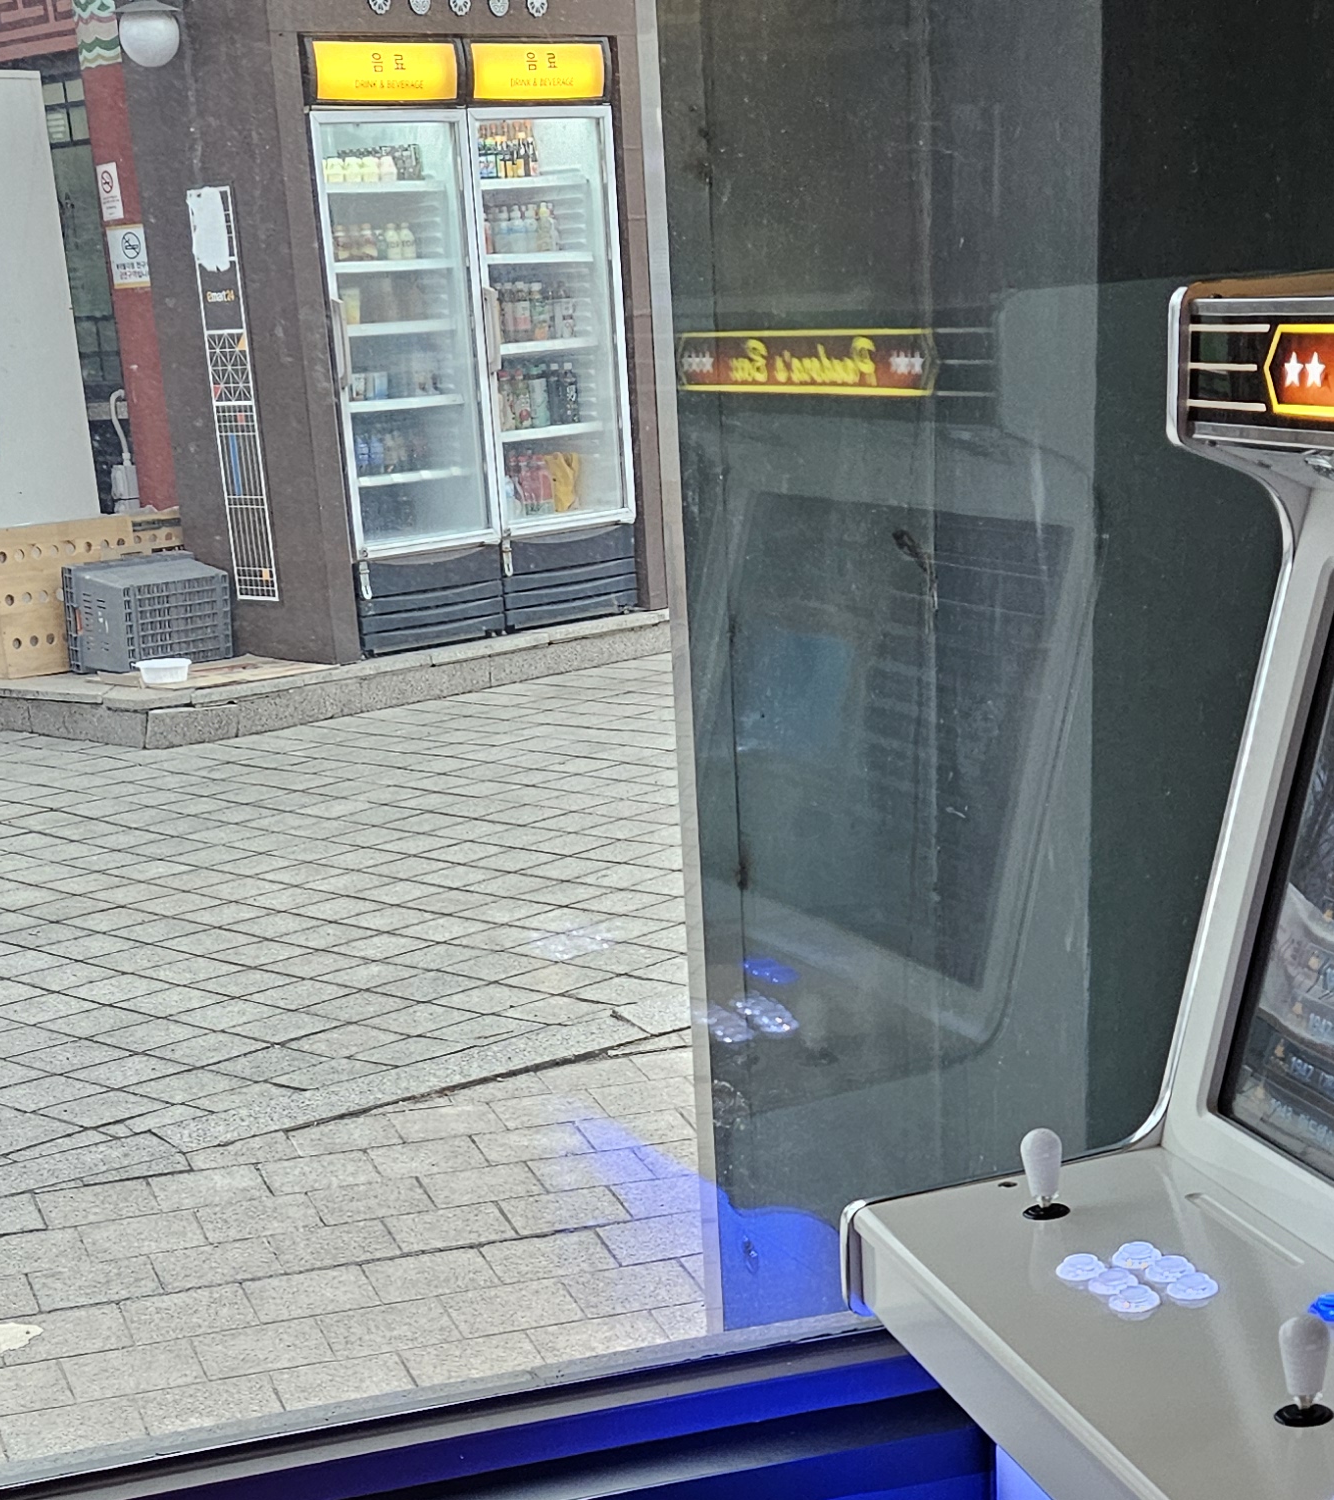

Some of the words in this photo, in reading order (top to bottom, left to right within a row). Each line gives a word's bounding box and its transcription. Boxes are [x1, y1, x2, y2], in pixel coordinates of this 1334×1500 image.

[371, 52, 406, 73] 음료
[526, 51, 558, 72] 음료
[354, 79, 377, 90] DRINK
[386, 79, 424, 90] BEVERAGE
[509, 77, 532, 88] DRINK
[539, 76, 574, 88] BEVERAGE
[205, 289, 235, 303] emart24
